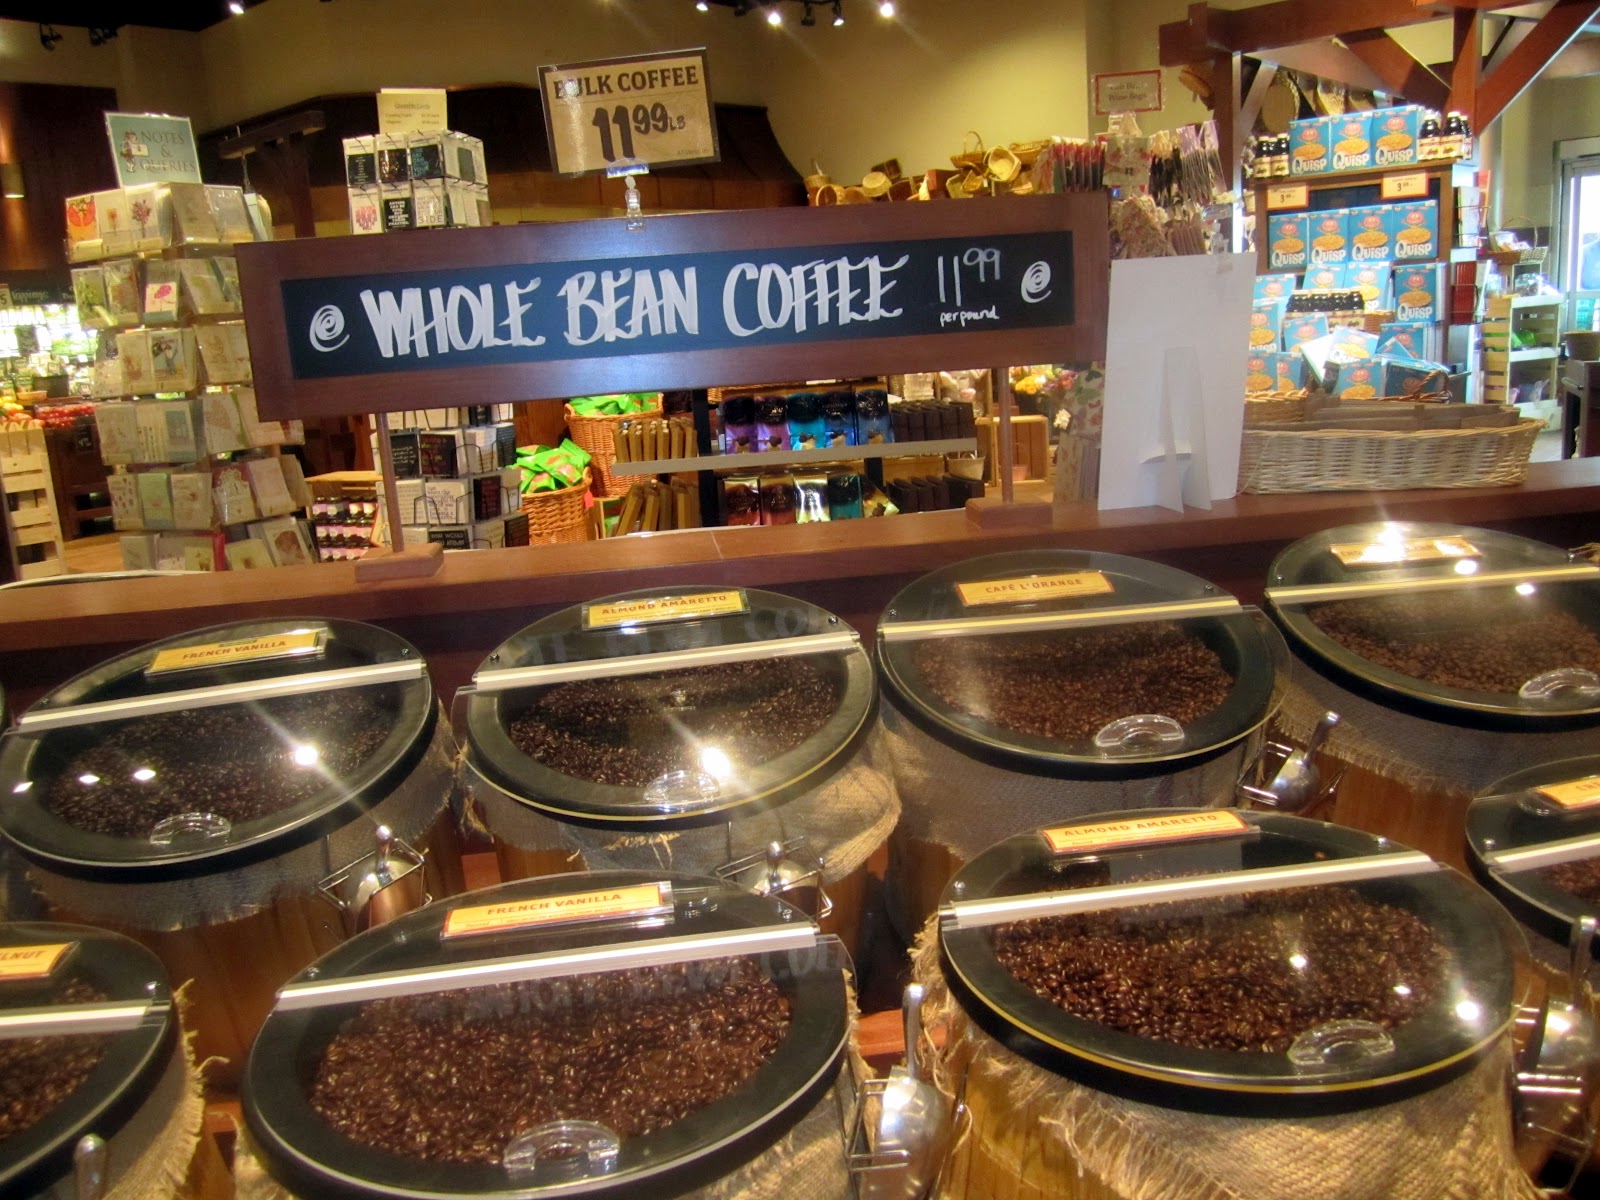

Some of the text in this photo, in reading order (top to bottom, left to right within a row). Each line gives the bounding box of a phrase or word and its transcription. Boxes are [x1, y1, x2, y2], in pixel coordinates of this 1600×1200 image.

[617, 65, 699, 92] COFFEE
[141, 130, 185, 144] NOTES
[161, 145, 172, 157] &
[140, 158, 196, 173] QUERIES
[418, 214, 443, 224] SIDE
[359, 277, 546, 358] WHOLE
[556, 266, 699, 346] BEAN
[722, 254, 910, 337] COFFEE
[1020, 578, 1083, 590] L'ORANGE
[602, 603, 656, 614] ALMOND
[660, 595, 727, 608] AMARETTO
[182, 640, 287, 660] FRENCH VANILLA
[1064, 823, 1130, 836] ALMOND
[1136, 814, 1218, 830] AMARETTO
[487, 901, 550, 916] FRENCH
[556, 892, 622, 908] VANILLA
